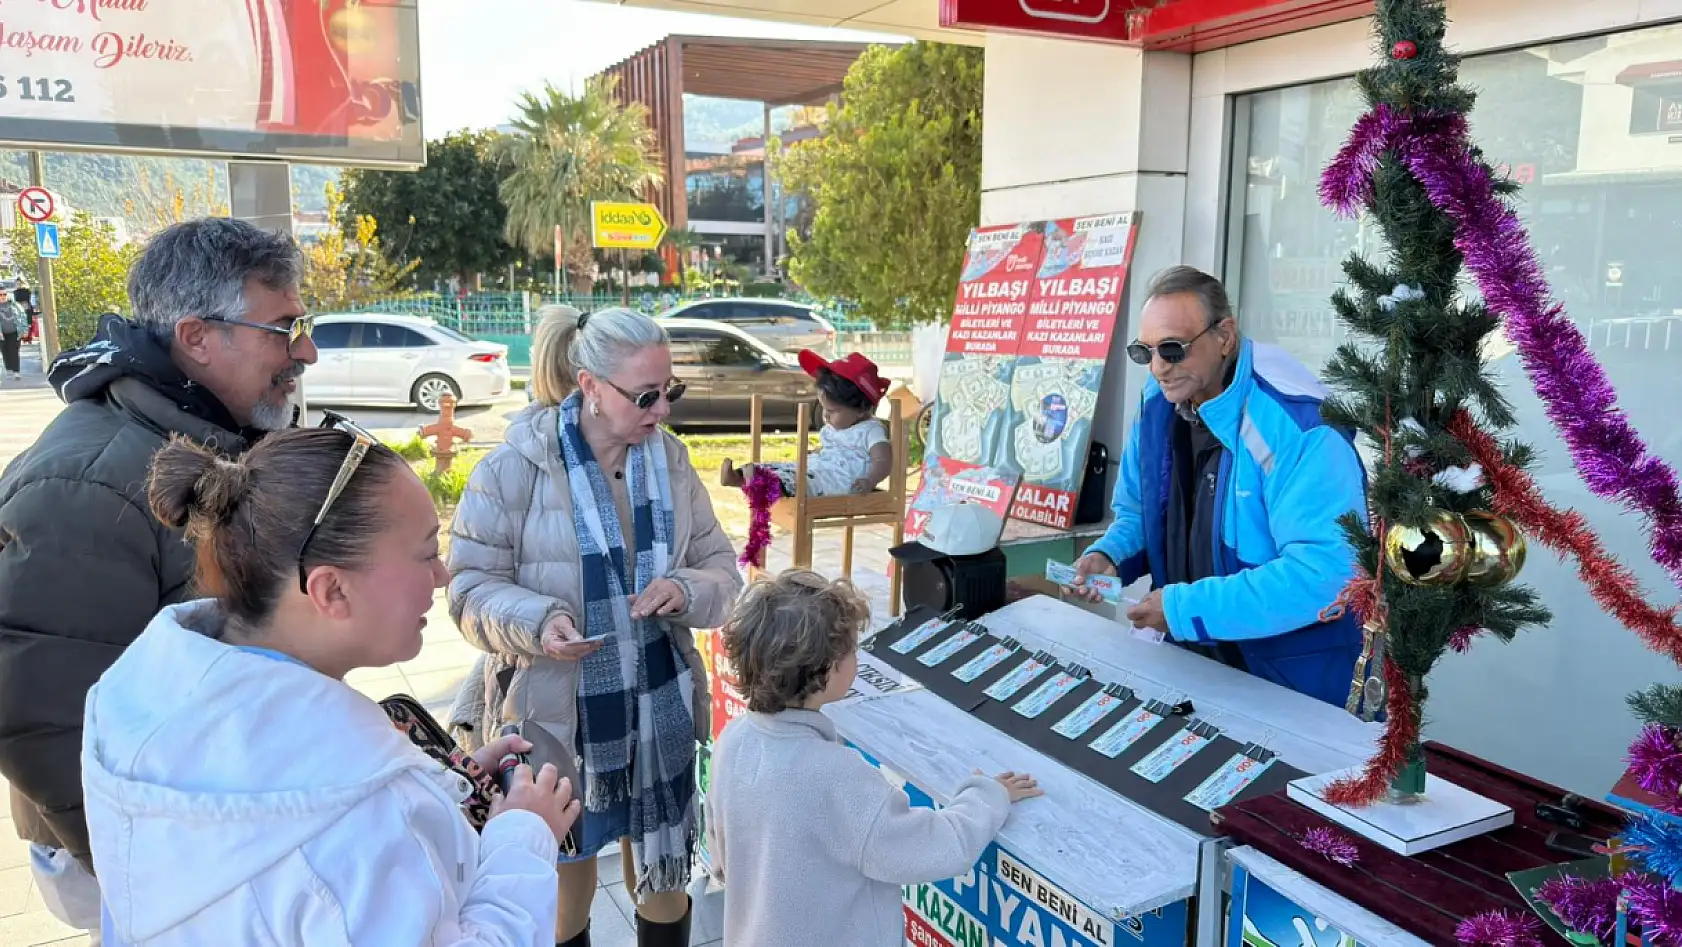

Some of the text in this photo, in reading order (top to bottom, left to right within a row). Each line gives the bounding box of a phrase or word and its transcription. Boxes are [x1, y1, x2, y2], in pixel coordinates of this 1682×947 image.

[0, 22, 194, 69] aşam Dileriz.
[17, 76, 75, 102] 112
[963, 280, 1029, 300] YILBAŞI
[1040, 276, 1119, 299] YILBAŞI
[981, 301, 1025, 315] PİYANGO
[1030, 299, 1115, 315] MİLLİ PİYANGO
[1036, 317, 1100, 330] BİLETLERİ VE
[1049, 332, 1105, 343] KAZANLARI
[1042, 344, 1080, 355] BURADA
[1017, 506, 1066, 528] OLABİLİR
[1000, 860, 1032, 894] SEN
[1037, 884, 1077, 925] BENİ
[1084, 917, 1106, 945] AL
